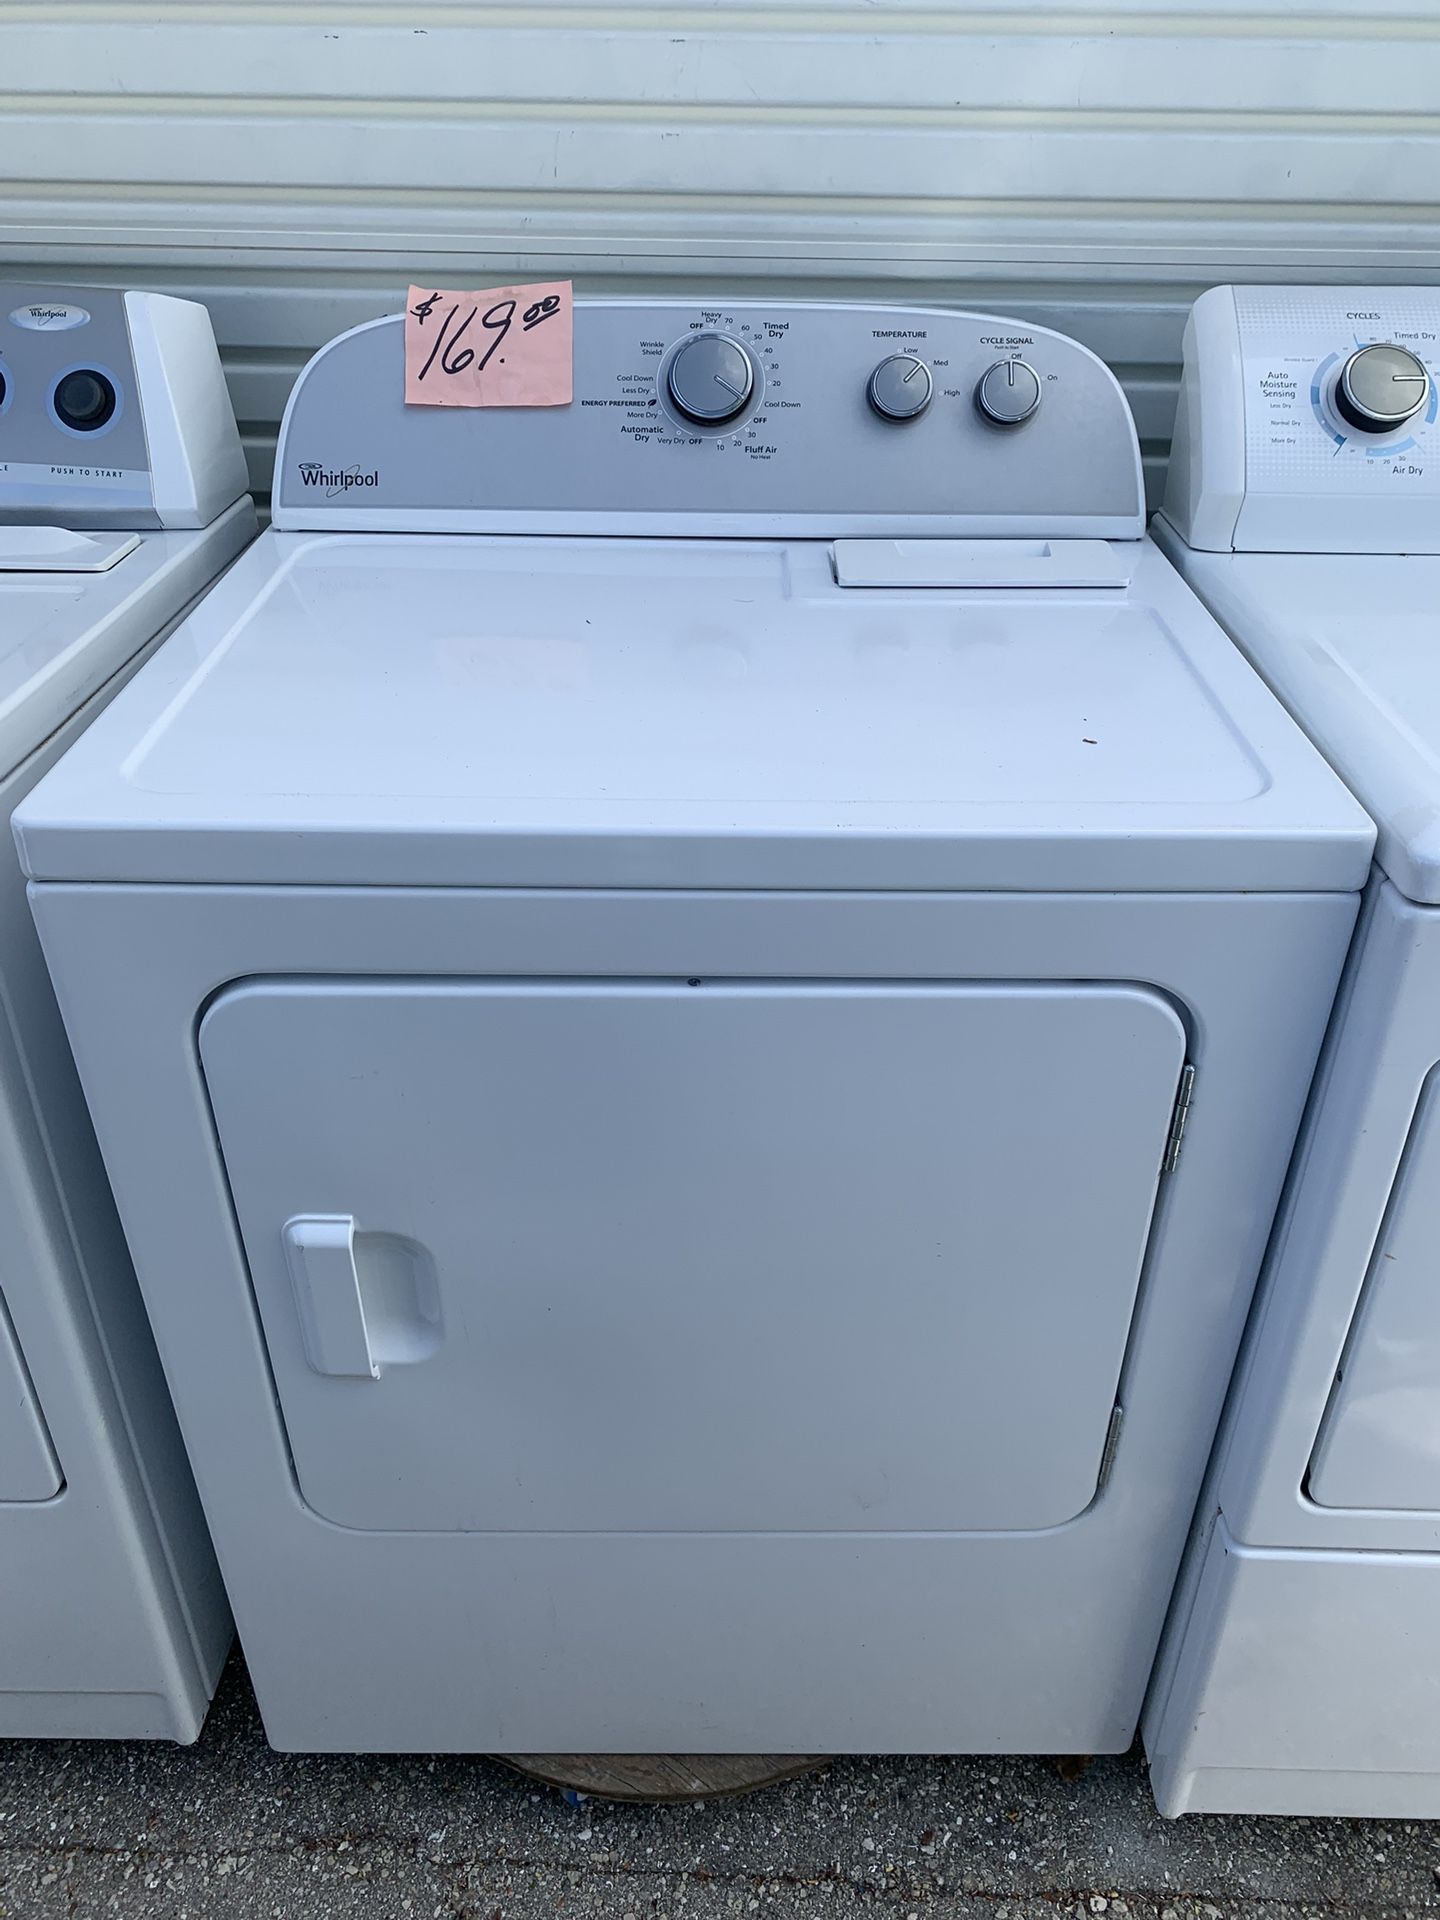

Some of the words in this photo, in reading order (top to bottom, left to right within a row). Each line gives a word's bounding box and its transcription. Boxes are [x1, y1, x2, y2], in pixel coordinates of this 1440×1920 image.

[30, 310, 67, 319] Whirlpool
[701, 311, 722, 319] Heavy
[1346, 312, 1381, 320] CYCLES
[763, 322, 790, 330] Timed
[769, 330, 784, 339] Dry
[1422, 332, 1436, 340] Dry
[1267, 371, 1289, 379] Auto
[1260, 381, 1298, 389] Moisture
[638, 387, 650, 395] Dry
[944, 389, 960, 397] High
[1262, 390, 1296, 399] Sensing
[621, 425, 664, 433] Automatic
[634, 434, 650, 442] Dry
[51, 467, 74, 475] PUSH
[95, 470, 122, 478] START
[1392, 465, 1406, 474] Air
[1408, 466, 1423, 476] Dry
[301, 470, 378, 491] Whirlpool
